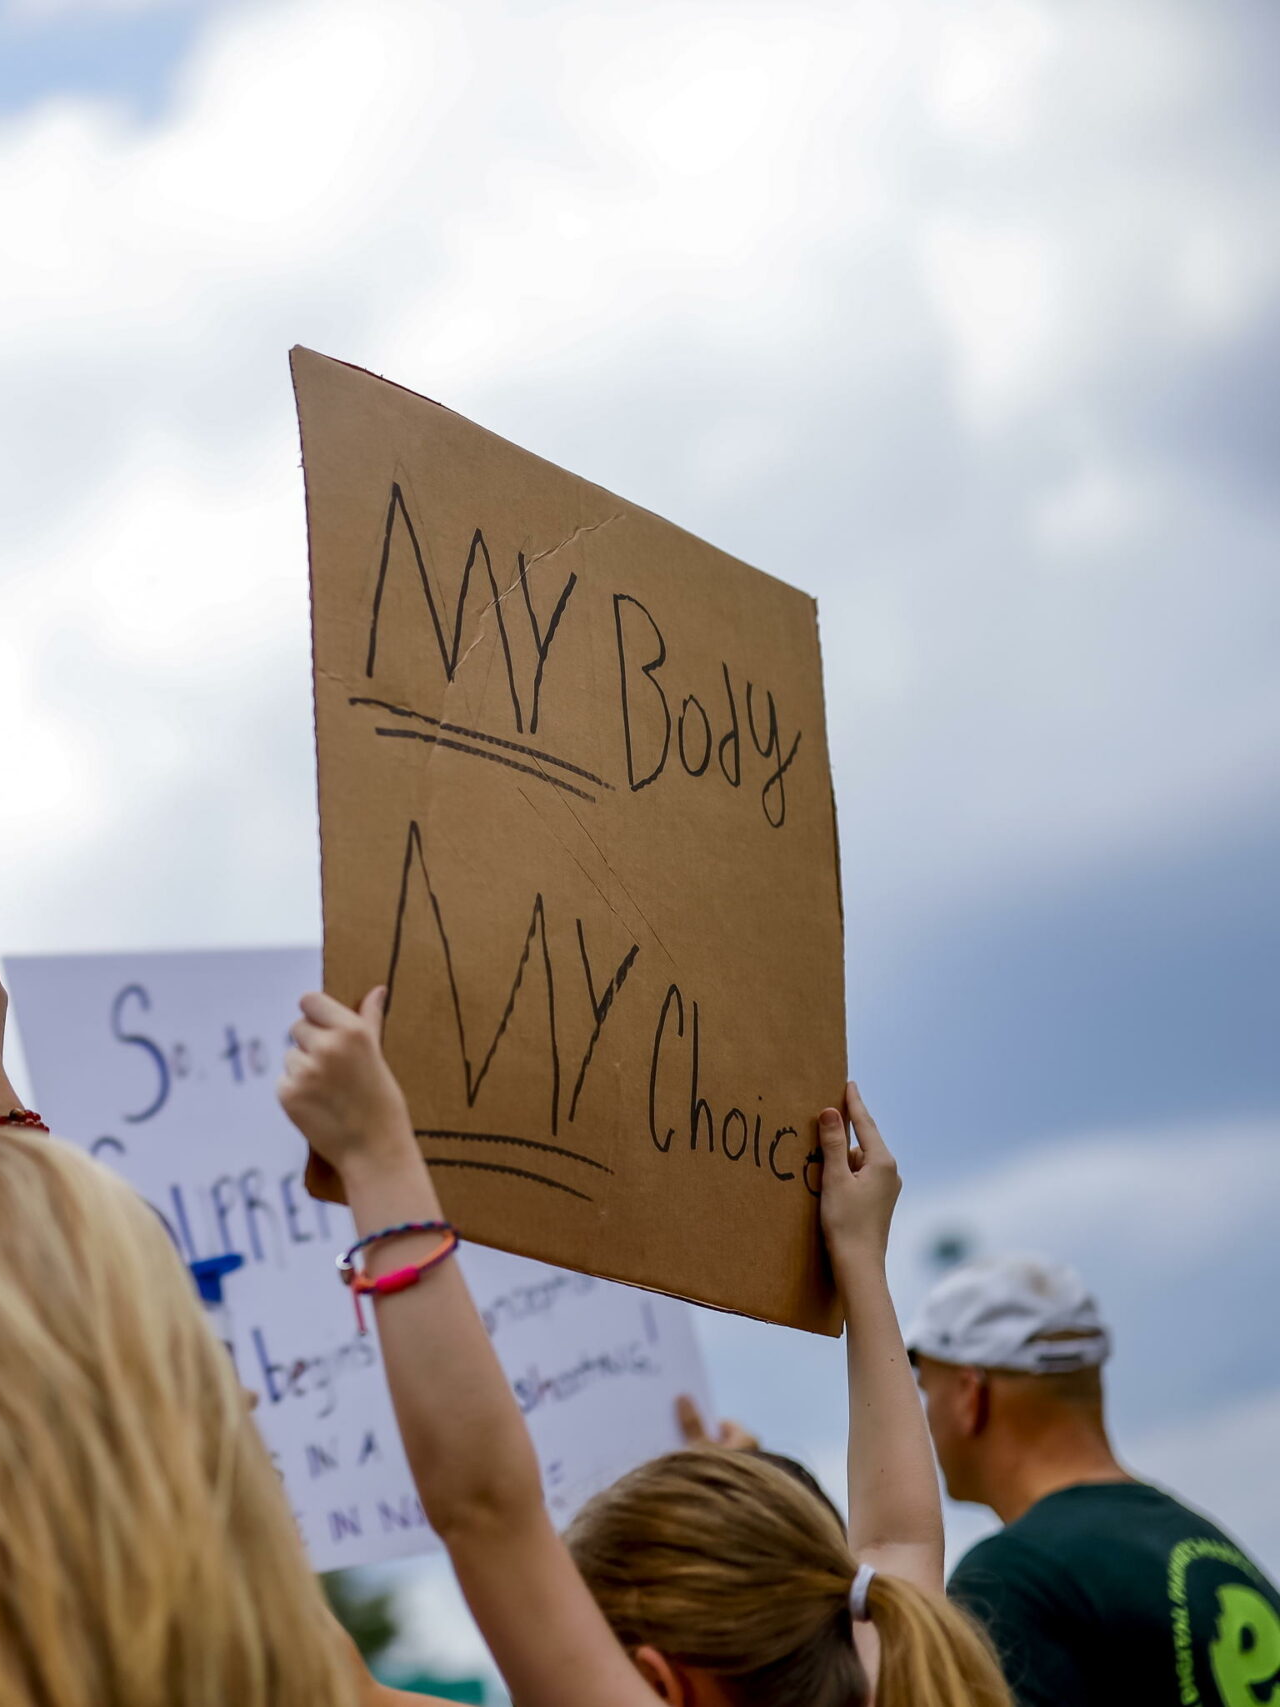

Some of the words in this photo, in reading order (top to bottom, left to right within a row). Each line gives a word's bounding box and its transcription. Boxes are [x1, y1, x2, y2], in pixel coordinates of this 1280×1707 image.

[366, 482, 578, 735] MY
[612, 592, 802, 829] Body
[382, 819, 640, 1137] MY
